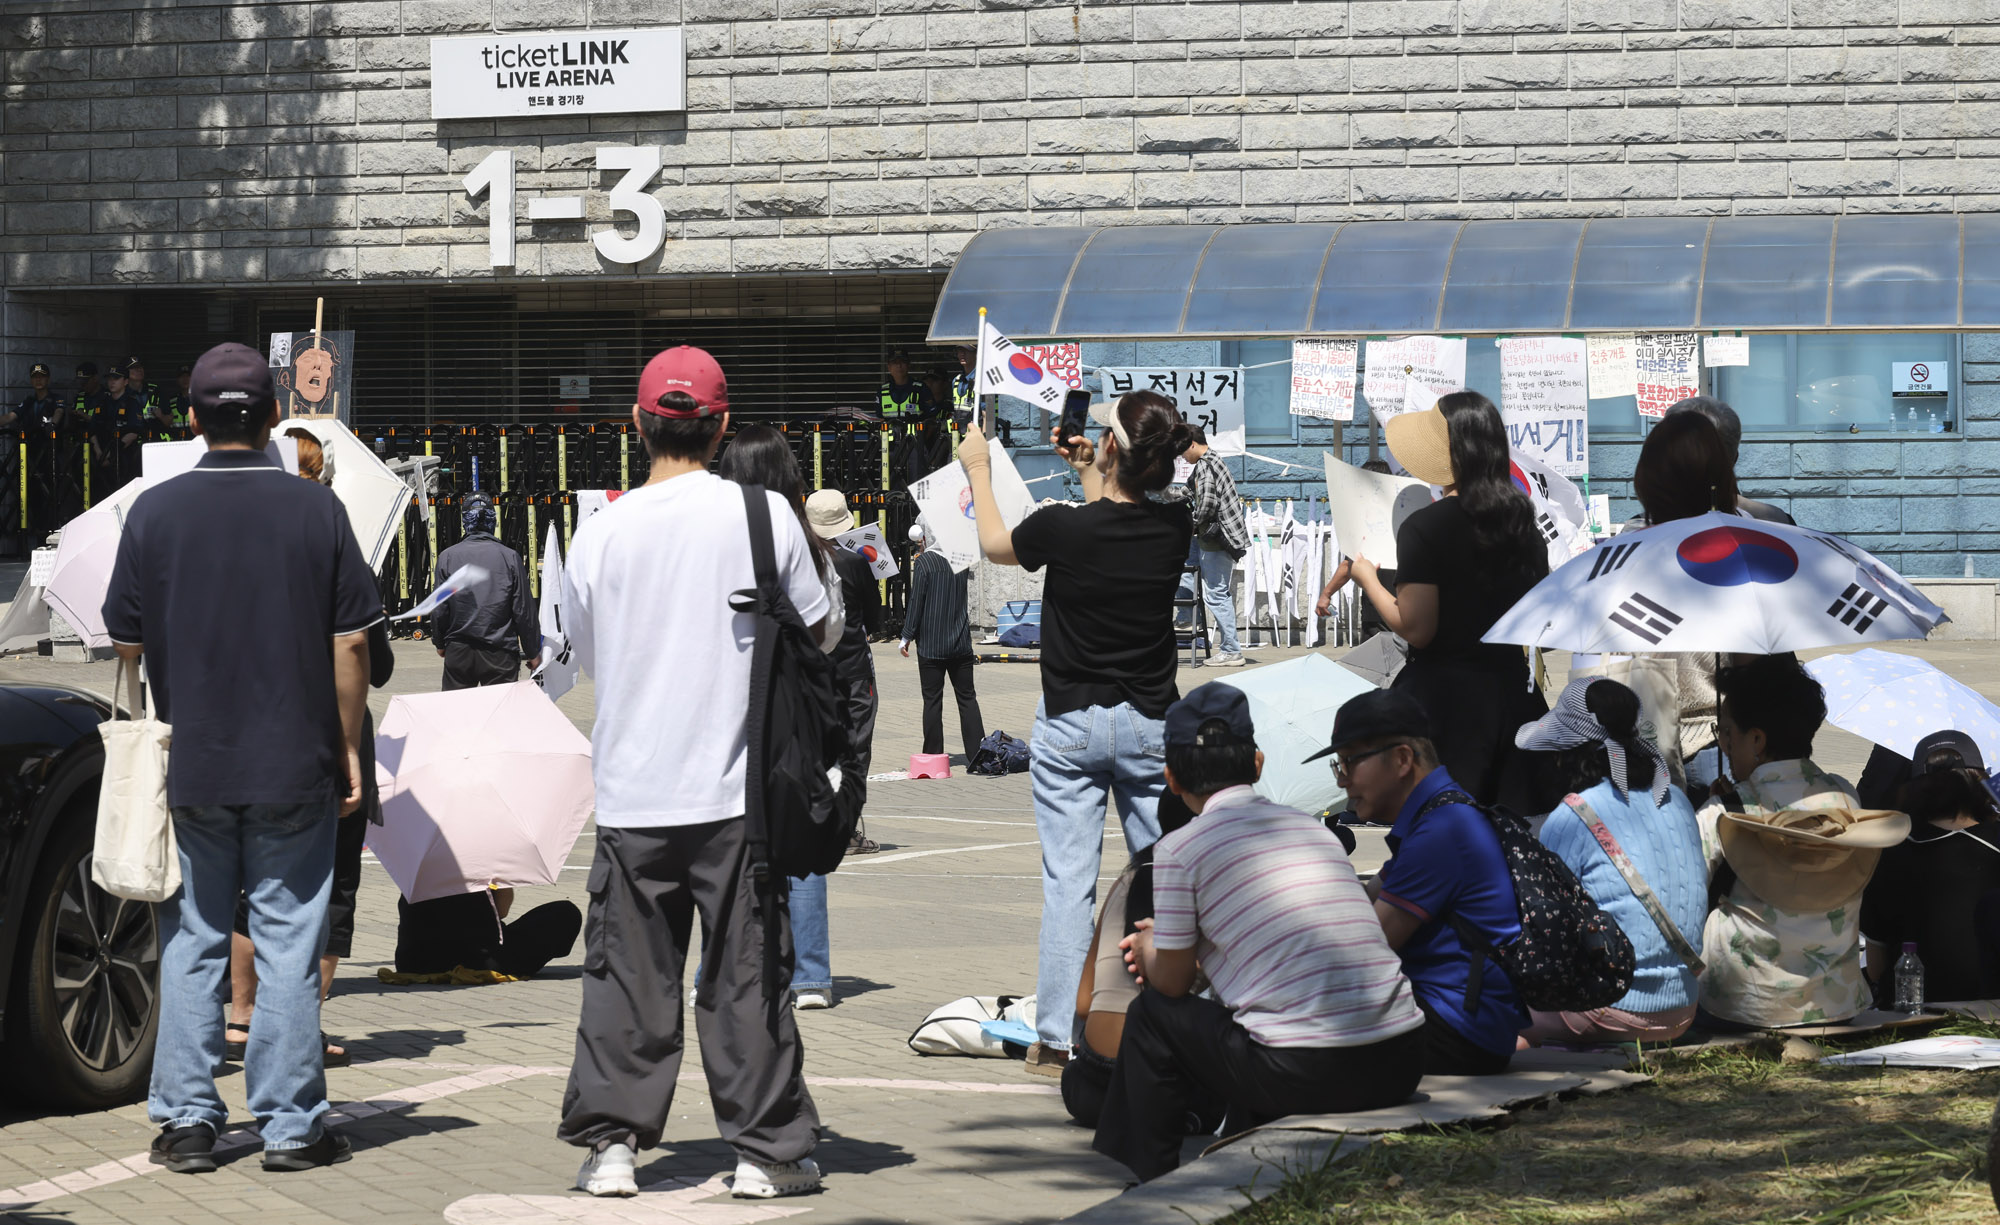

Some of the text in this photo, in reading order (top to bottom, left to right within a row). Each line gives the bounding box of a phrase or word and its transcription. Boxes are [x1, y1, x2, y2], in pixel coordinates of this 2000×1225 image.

[481, 40, 630, 69] ticketLINK
[497, 68, 615, 89] LIVE ARENA
[528, 94, 585, 107] 핸드볼 경기장
[461, 145, 667, 267] 1-3
[1674, 334, 1697, 347] 프랑스
[1022, 342, 1080, 369] 거소청
[1590, 346, 1627, 364] 집중개표
[1636, 348, 1654, 359] 이미
[1656, 347, 1696, 362] 실시중!
[1636, 359, 1688, 374] 대한민국도
[1636, 371, 1693, 388] 이제부터는
[1638, 400, 1674, 417] 현장수
